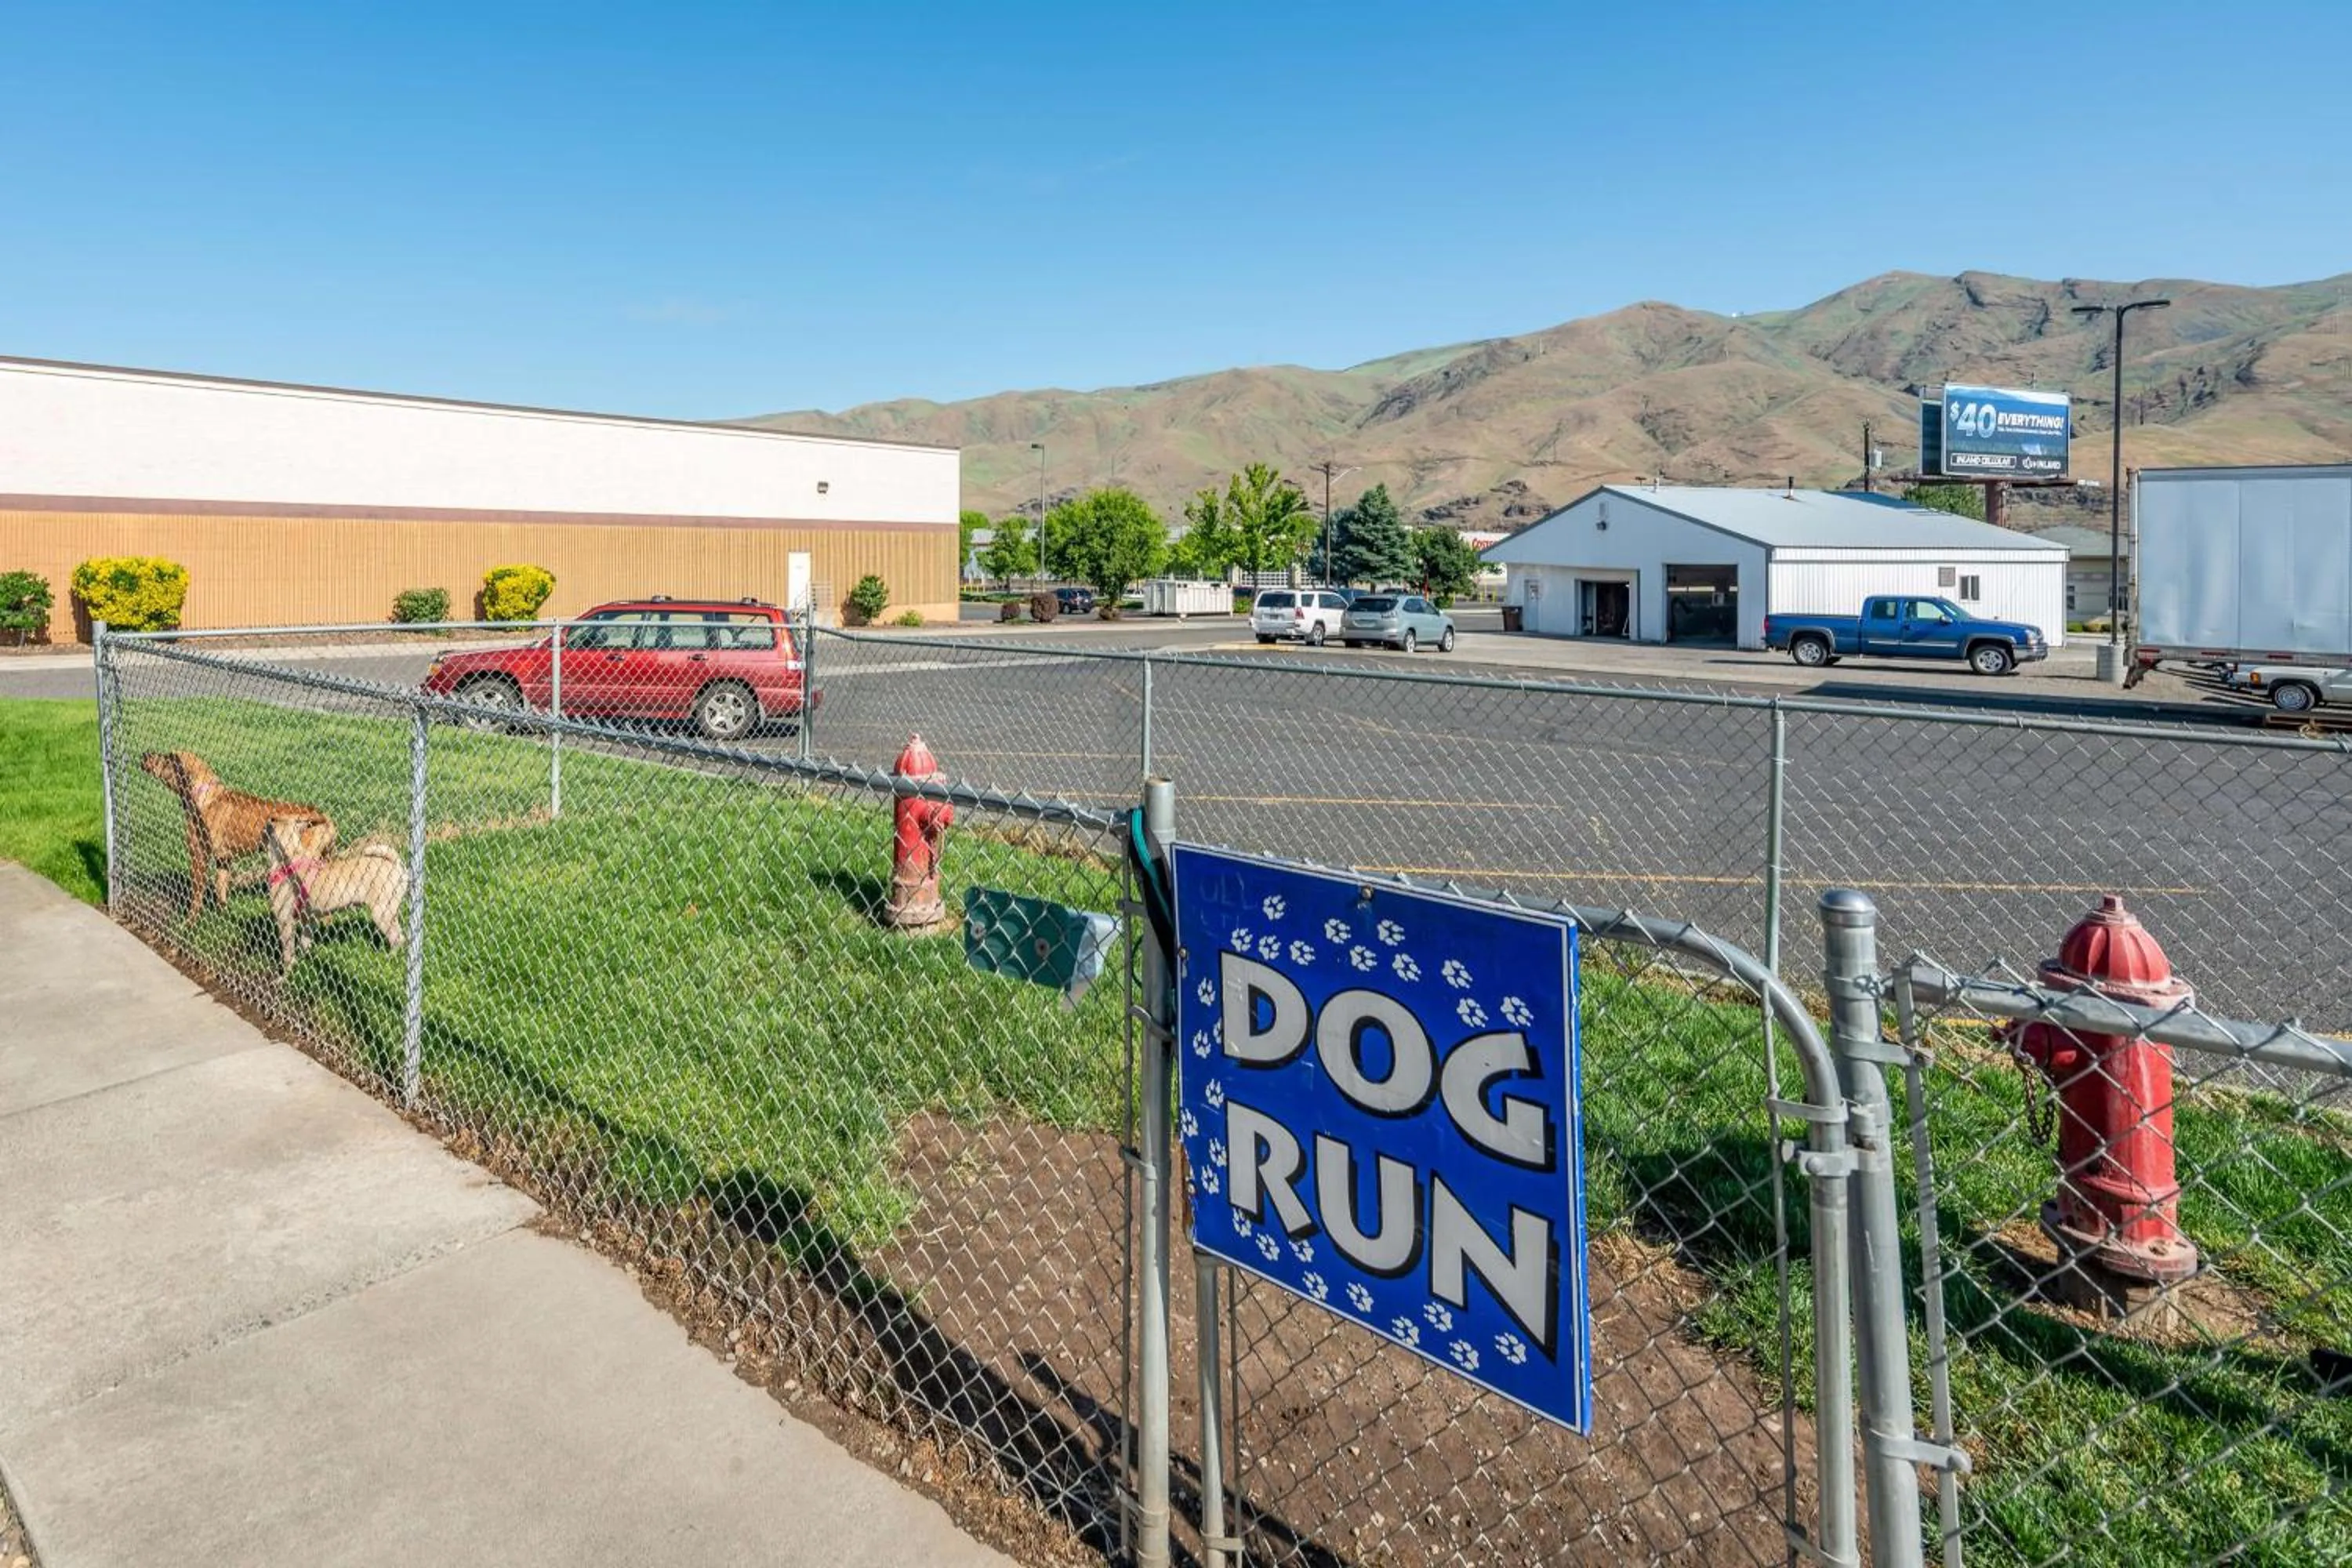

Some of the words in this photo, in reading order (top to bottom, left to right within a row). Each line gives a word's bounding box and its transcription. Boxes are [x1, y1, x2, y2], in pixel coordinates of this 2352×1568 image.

[1950, 401, 1997, 438] $40
[1997, 412, 2064, 430] EVERYTHING!
[1220, 951, 1556, 1172] DOG
[1226, 1101, 1558, 1364] RUN
